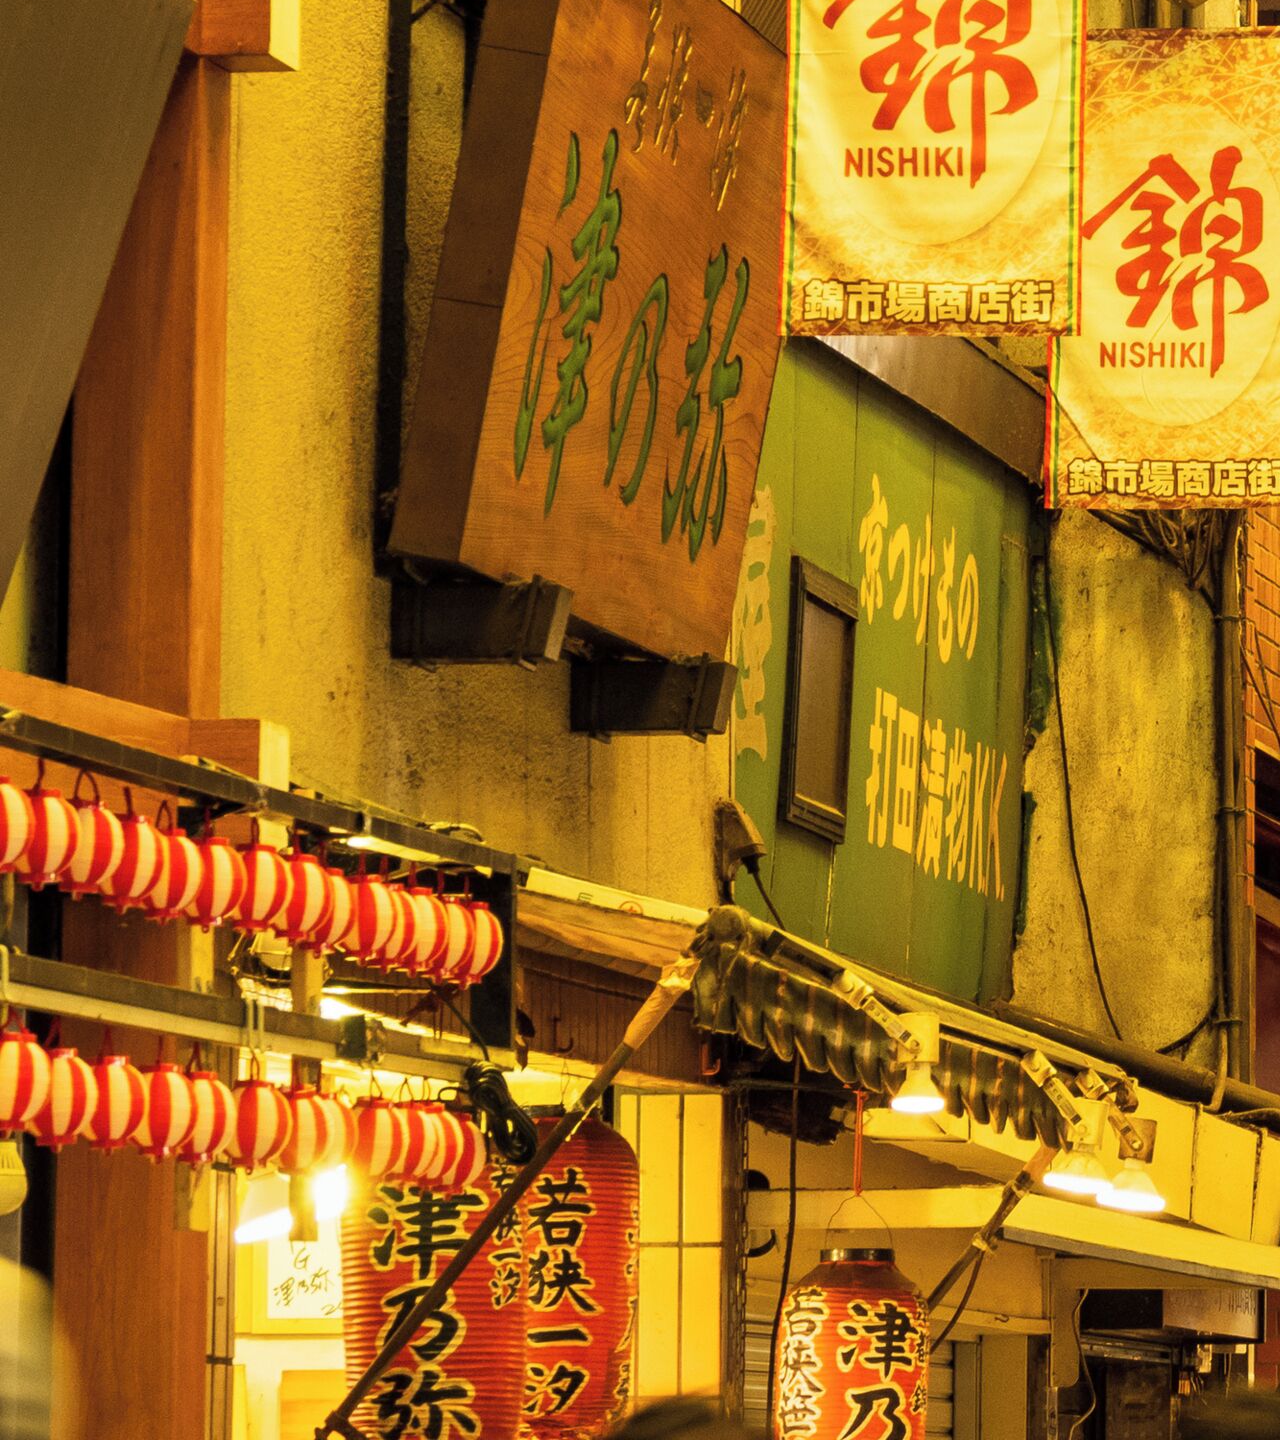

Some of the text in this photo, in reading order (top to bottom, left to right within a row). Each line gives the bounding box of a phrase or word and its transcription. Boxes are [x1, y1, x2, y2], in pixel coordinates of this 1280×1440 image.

[844, 146, 966, 178] NISHIKI
[802, 280, 1055, 327] 錦市場商店街
[1081, 145, 1270, 379] 錦
[1099, 341, 1206, 370] NISHIKI
[858, 473, 979, 664] 京つけもの
[527, 1168, 604, 1417] 若狭一汐
